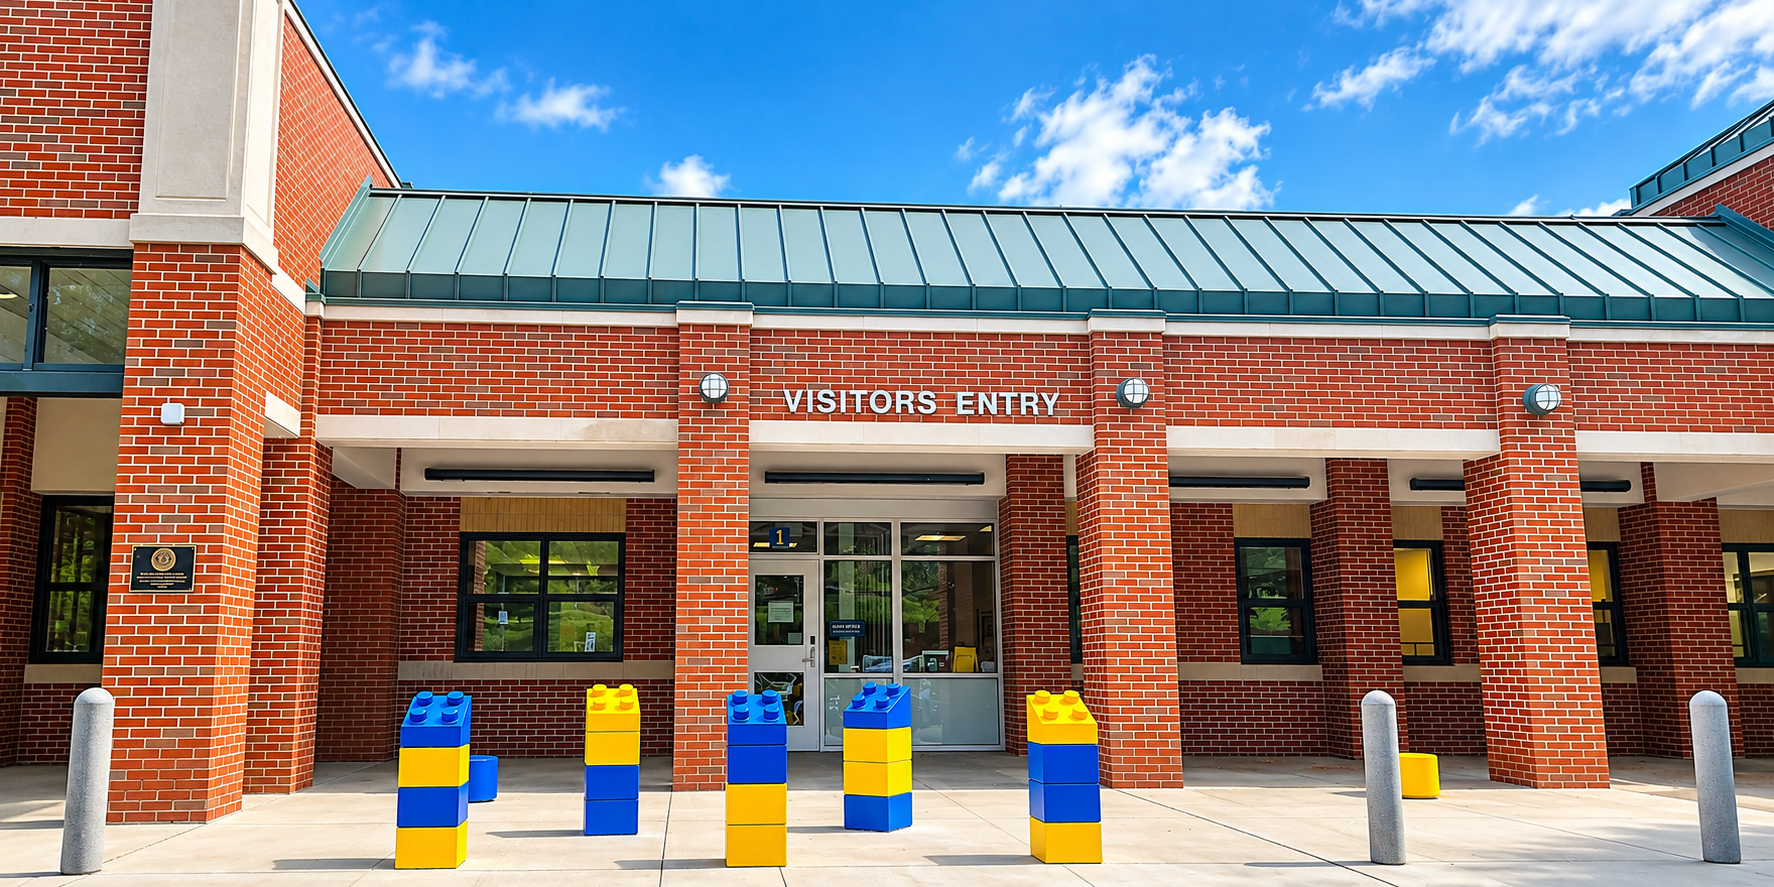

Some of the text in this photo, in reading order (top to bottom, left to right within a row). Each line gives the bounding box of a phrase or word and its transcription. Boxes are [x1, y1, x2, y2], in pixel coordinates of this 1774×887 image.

[783, 389, 1060, 416] VISITORS ENTRY
[776, 529, 784, 545] 1
